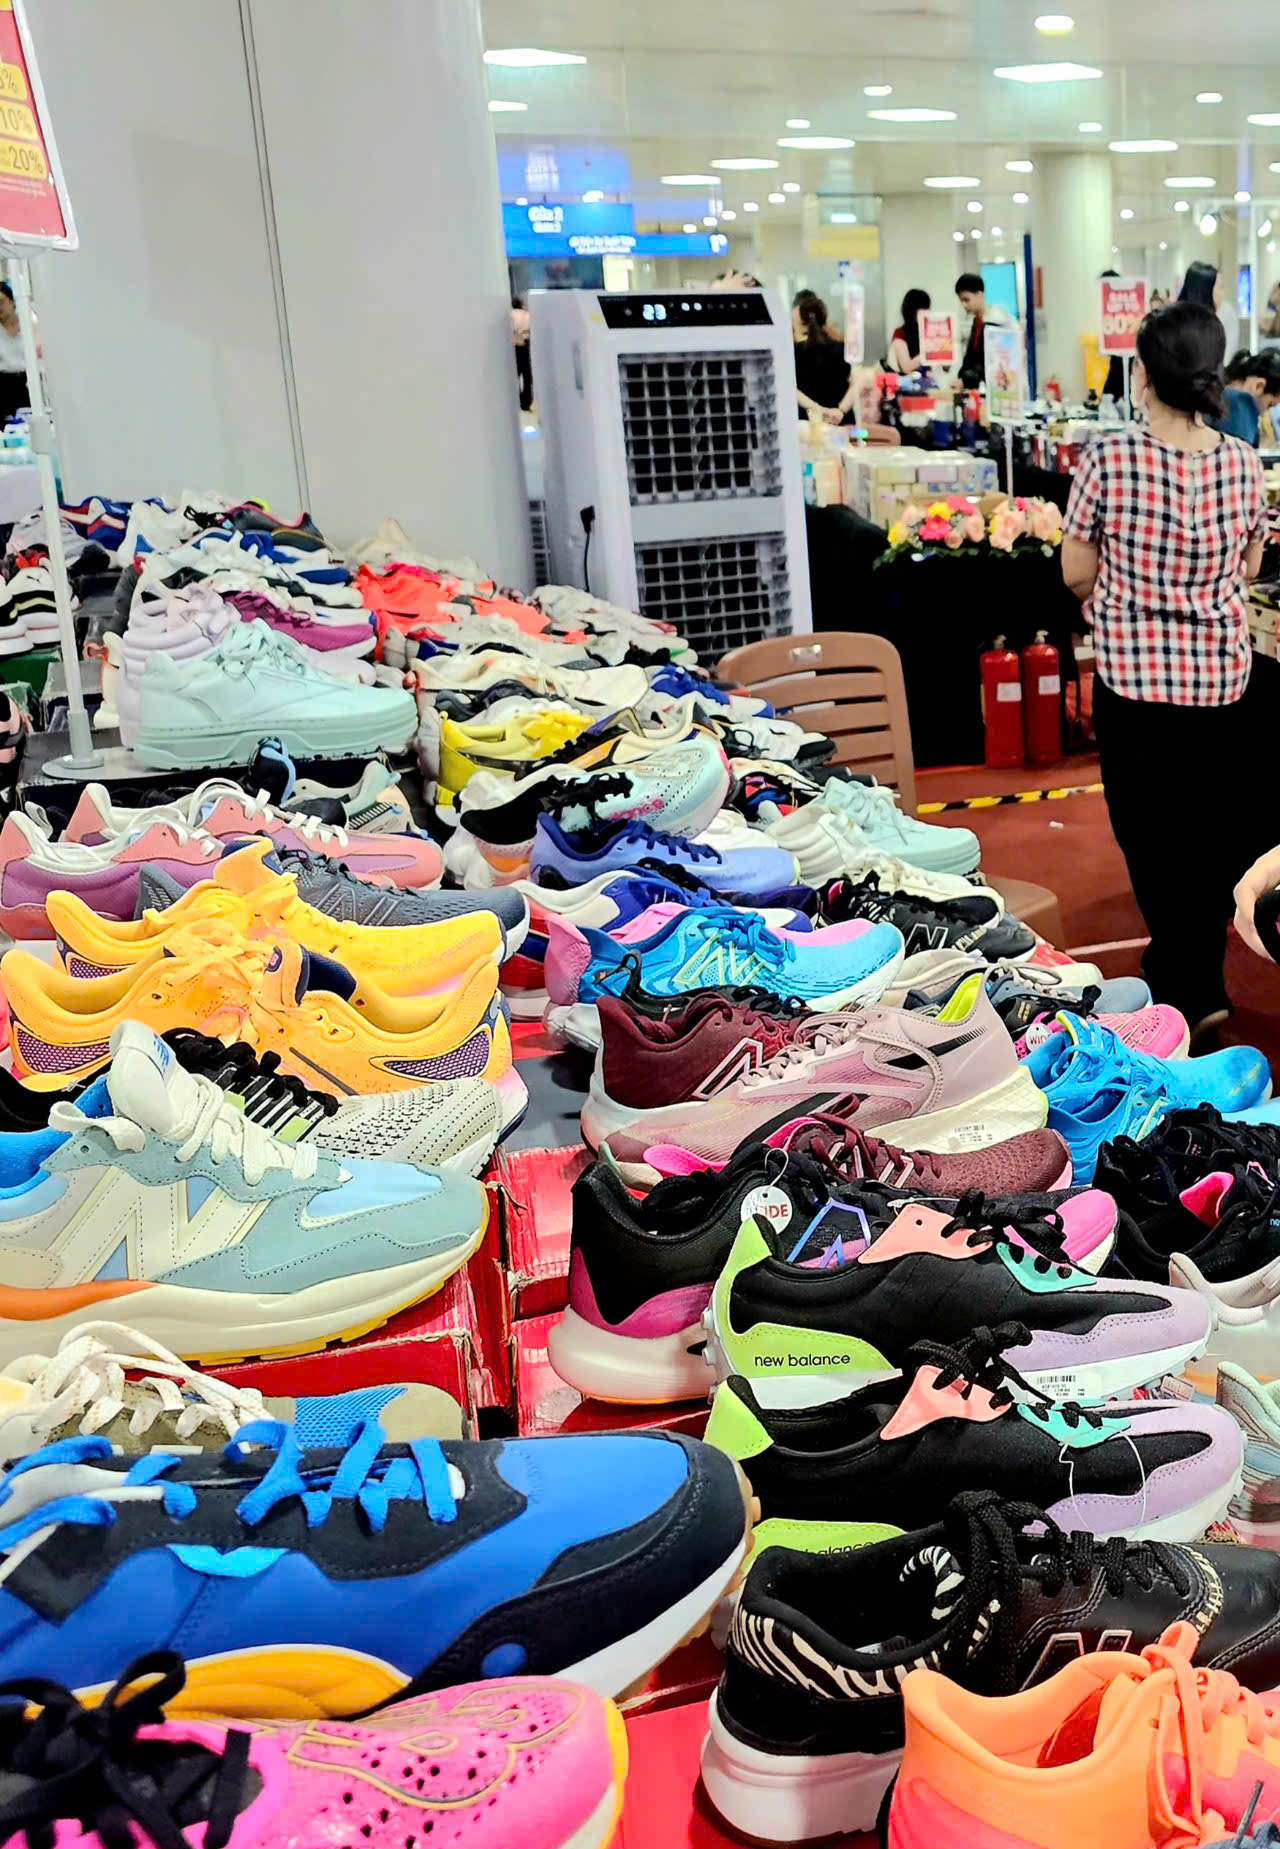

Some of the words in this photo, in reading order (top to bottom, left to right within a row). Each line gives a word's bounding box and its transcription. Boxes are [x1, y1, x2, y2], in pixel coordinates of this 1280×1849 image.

[9, 146, 44, 175] 20%
[754, 1356, 785, 1367] new
[788, 1354, 851, 1367] balance
